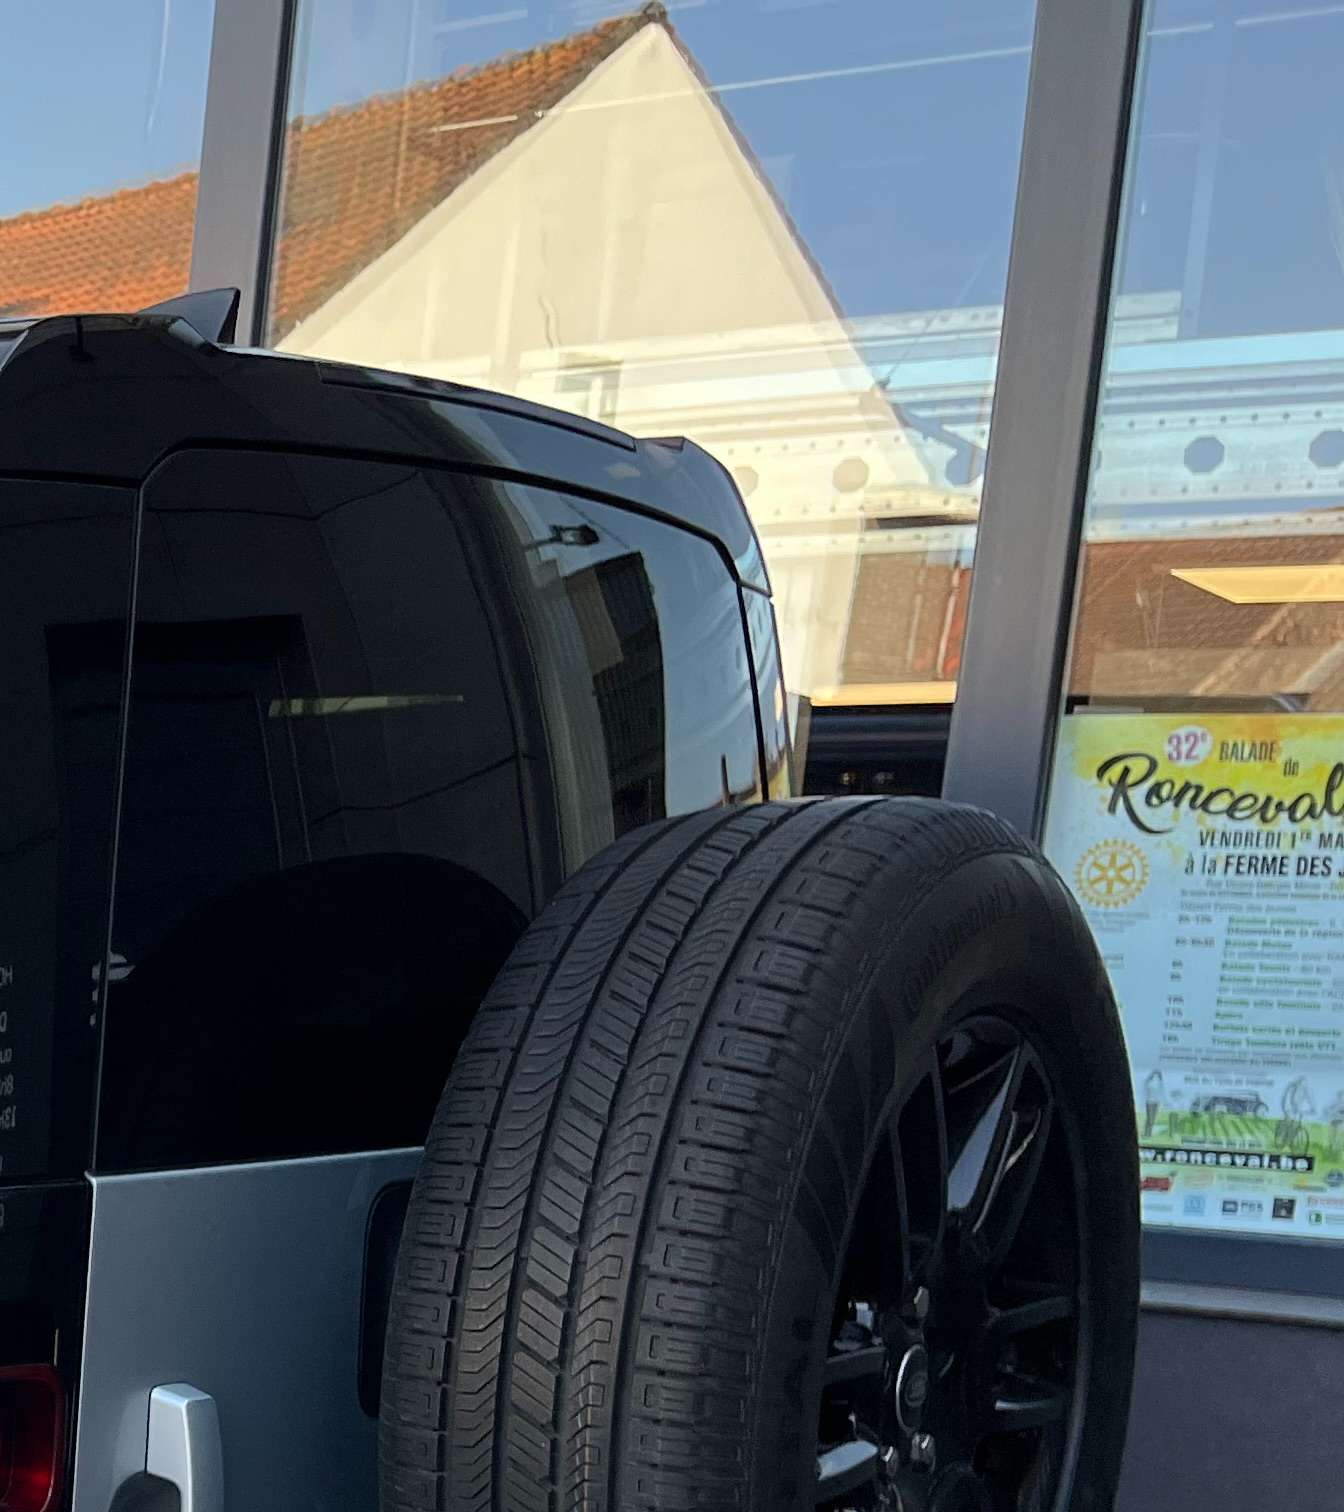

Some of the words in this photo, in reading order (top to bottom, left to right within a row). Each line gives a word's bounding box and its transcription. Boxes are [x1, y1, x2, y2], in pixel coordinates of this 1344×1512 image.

[1218, 739, 1278, 763] BALADE
[1199, 828, 1281, 848] VENDREDI
[1201, 855, 1217, 876] la
[1223, 855, 1289, 876] FERME
[1296, 856, 1333, 877] DES
